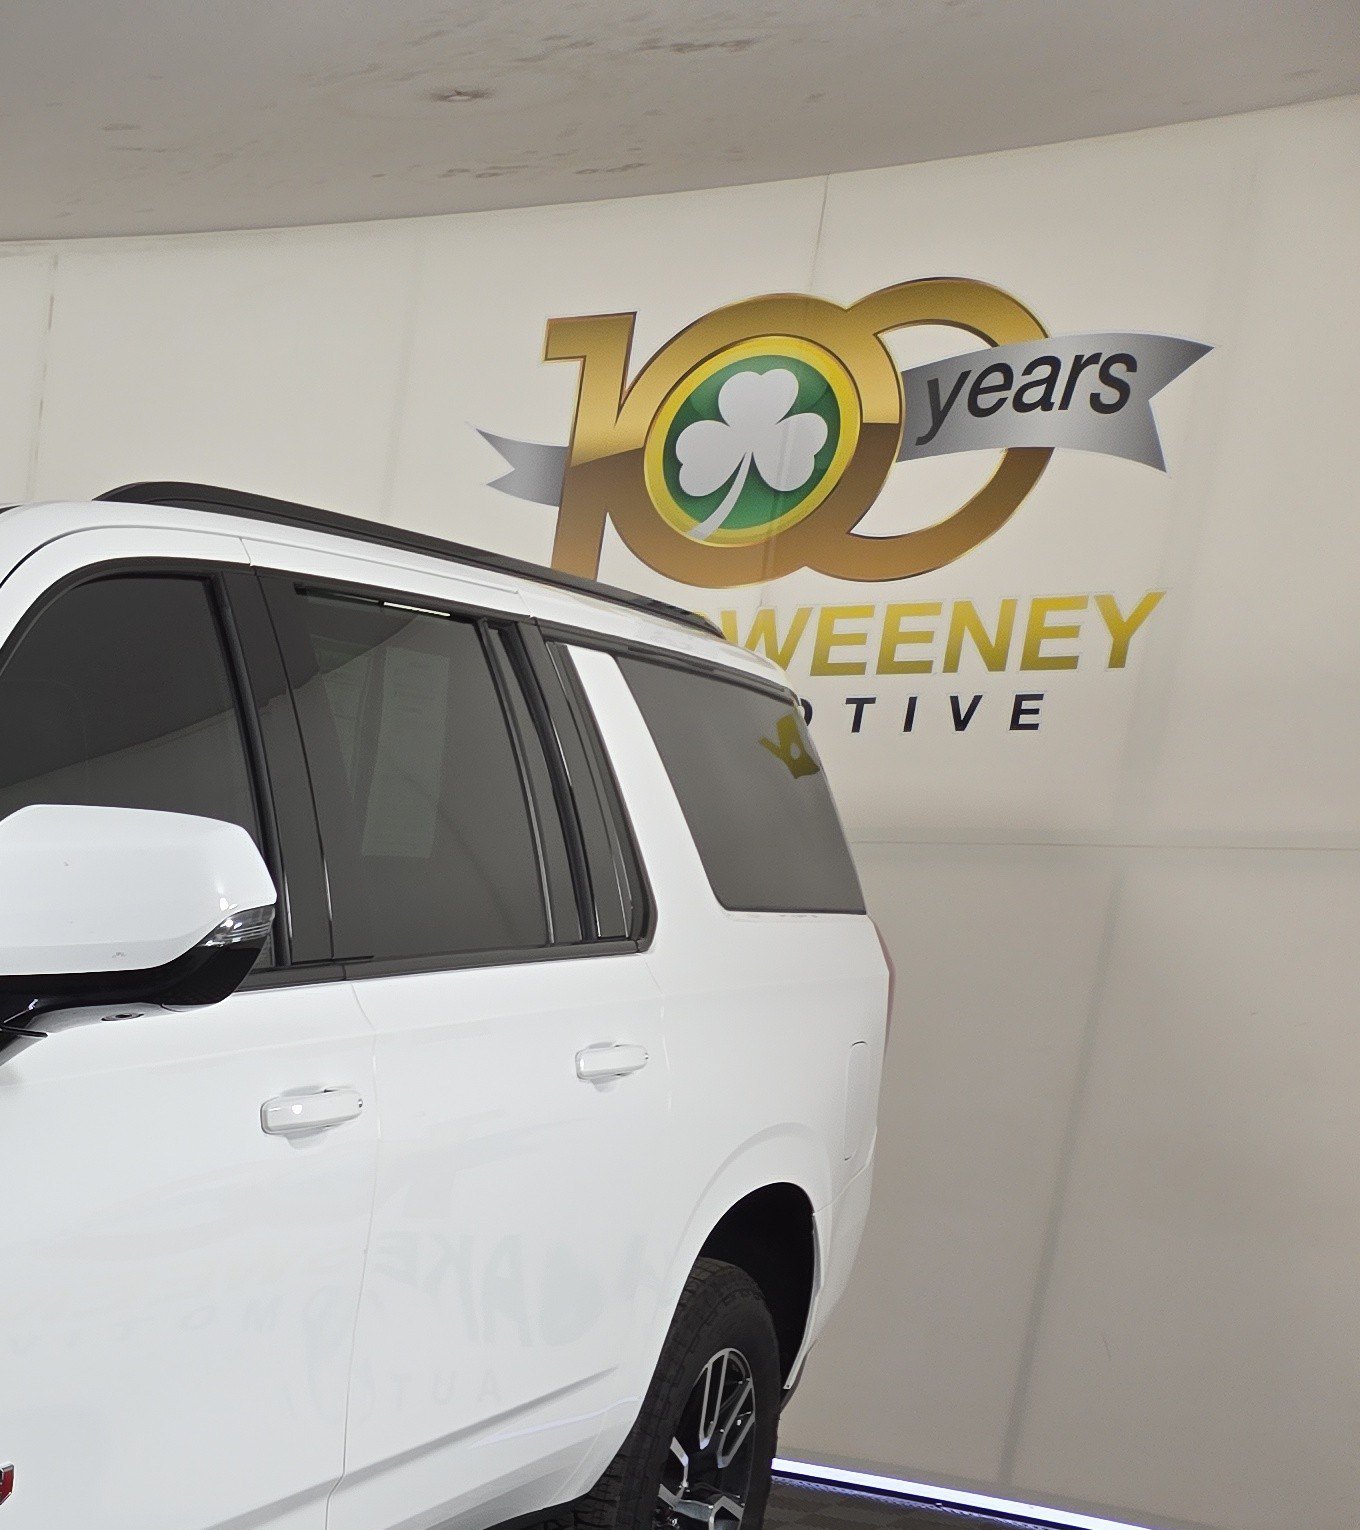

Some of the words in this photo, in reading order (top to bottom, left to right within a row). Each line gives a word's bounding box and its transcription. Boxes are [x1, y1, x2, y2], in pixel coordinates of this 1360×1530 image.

[543, 276, 1052, 588] 100
[916, 347, 1137, 444] years
[696, 590, 1165, 677] WEENEY
